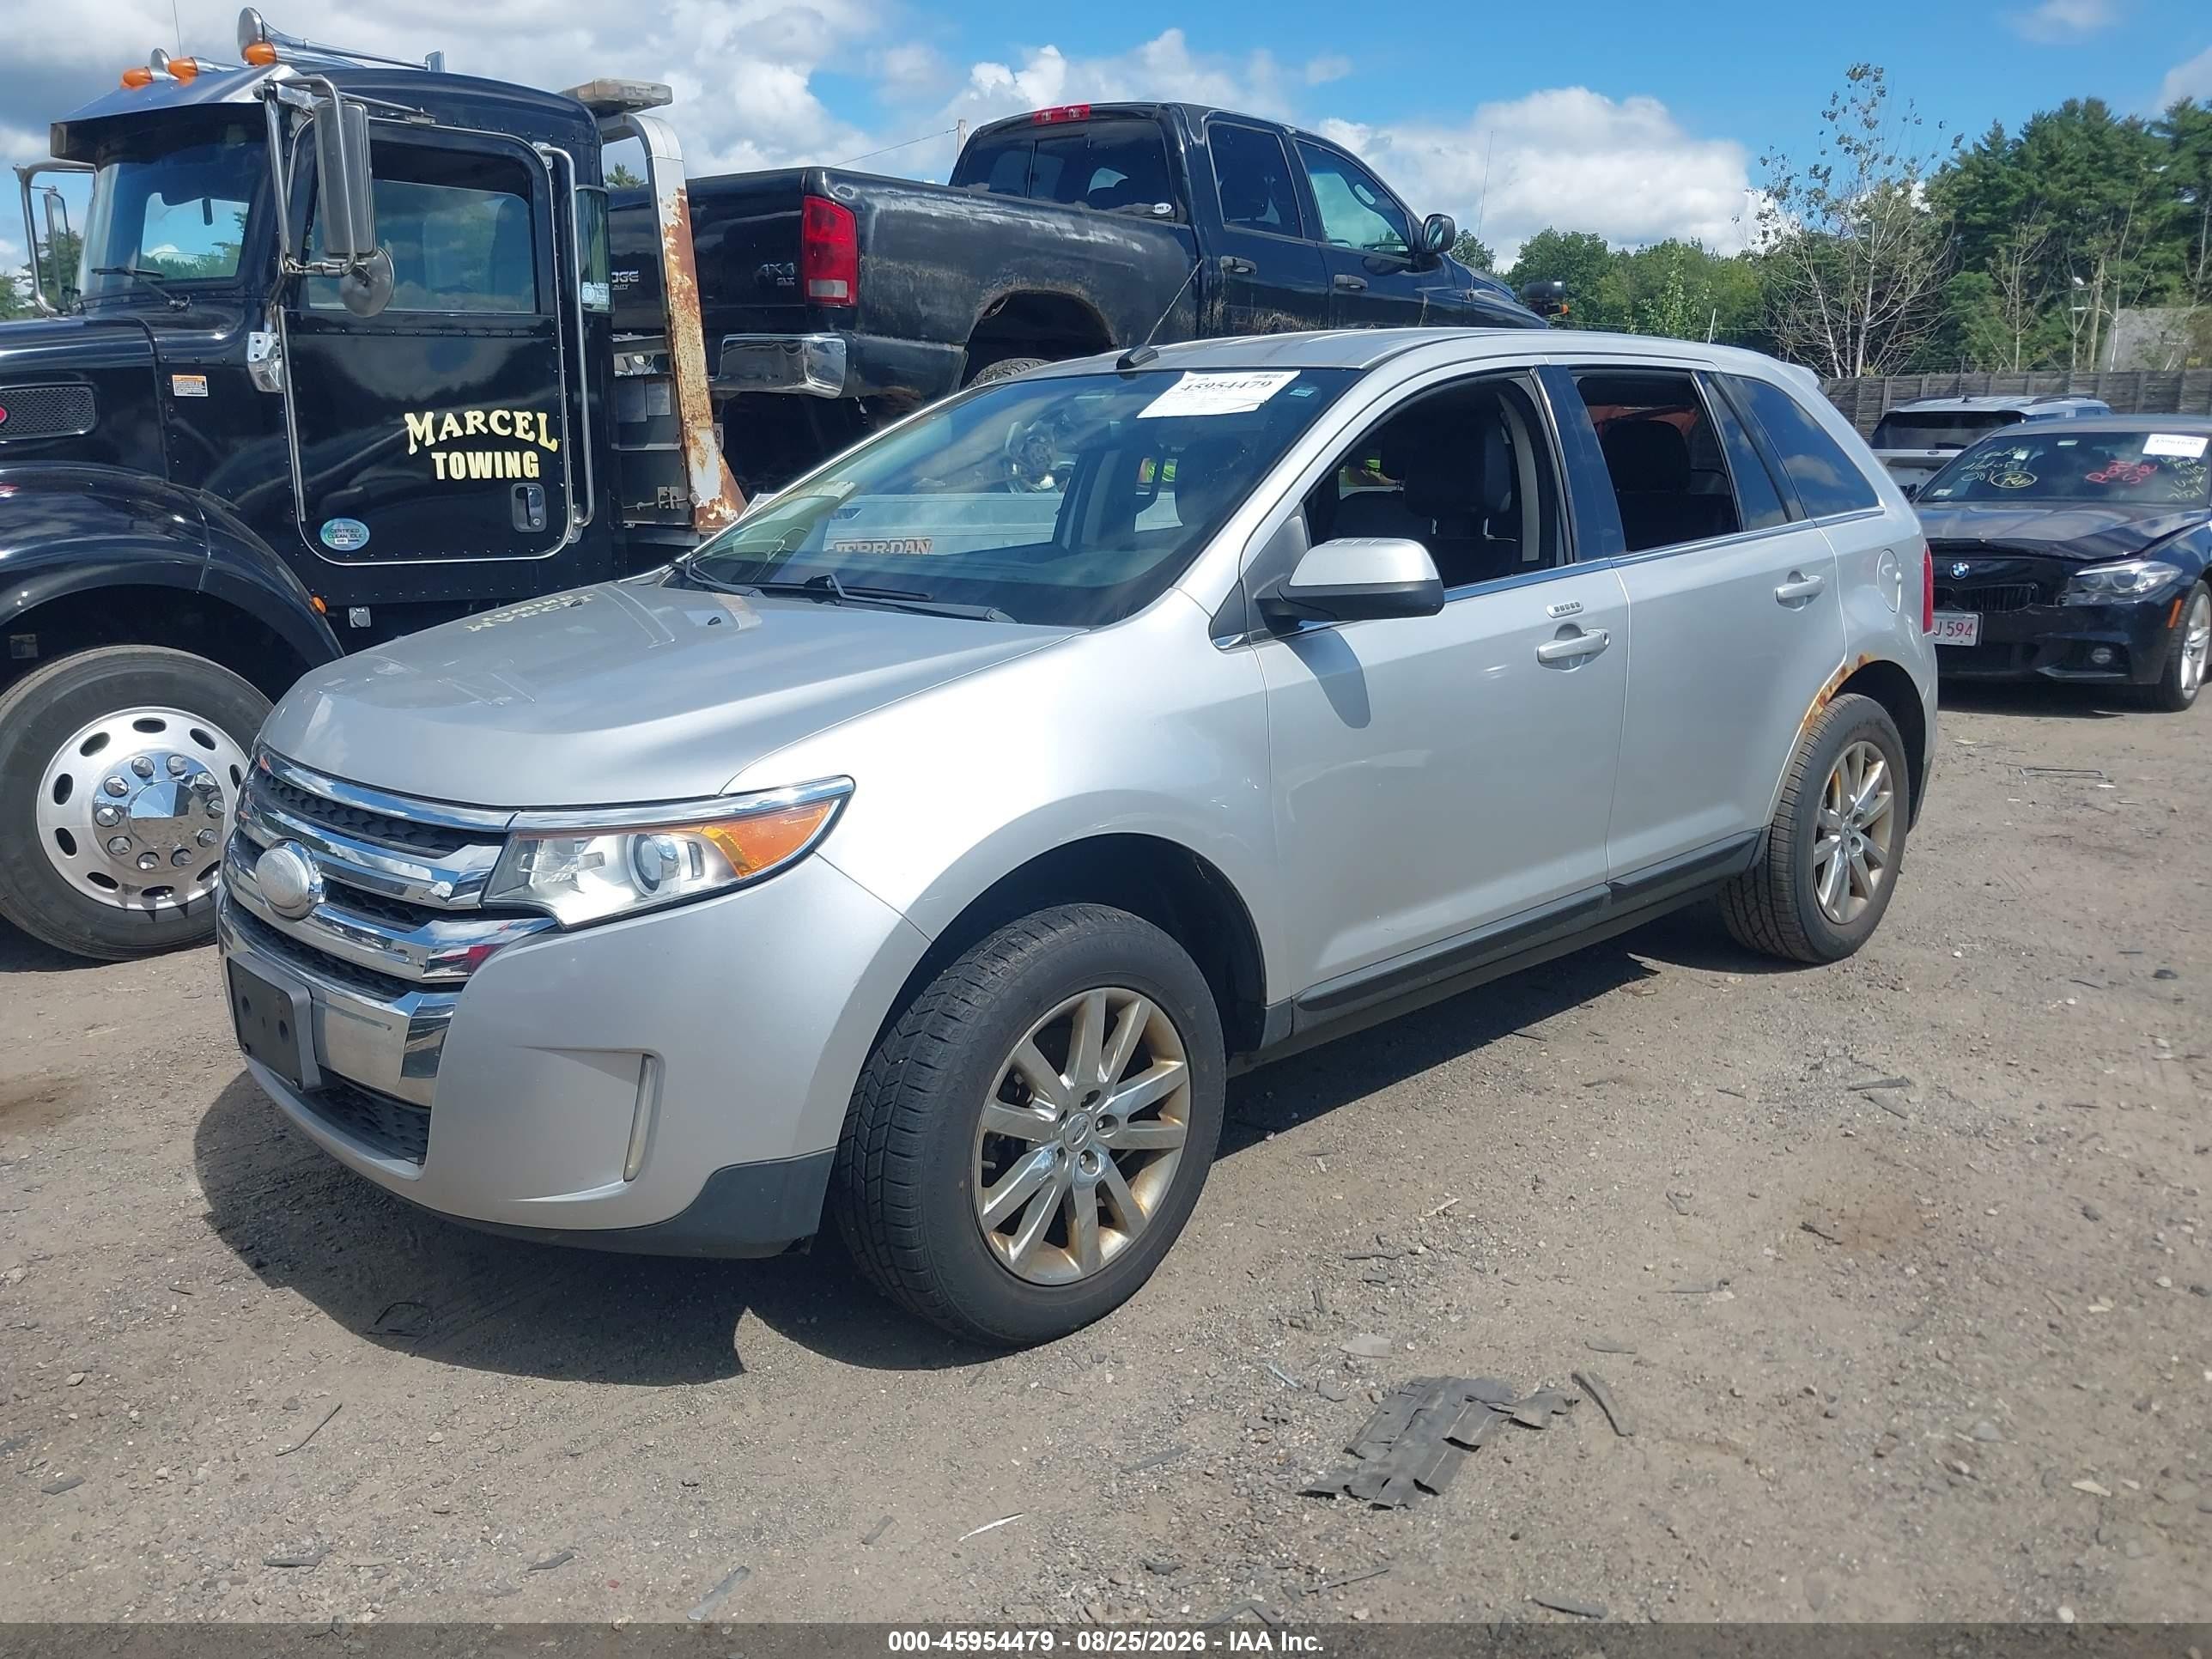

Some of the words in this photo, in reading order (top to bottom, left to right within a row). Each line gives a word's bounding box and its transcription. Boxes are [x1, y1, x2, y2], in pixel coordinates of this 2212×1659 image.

[1181, 380, 1273, 392] 45954479
[404, 409, 558, 455] MARCEL
[431, 451, 540, 480] TOWING
[1946, 621, 1973, 638] 594
